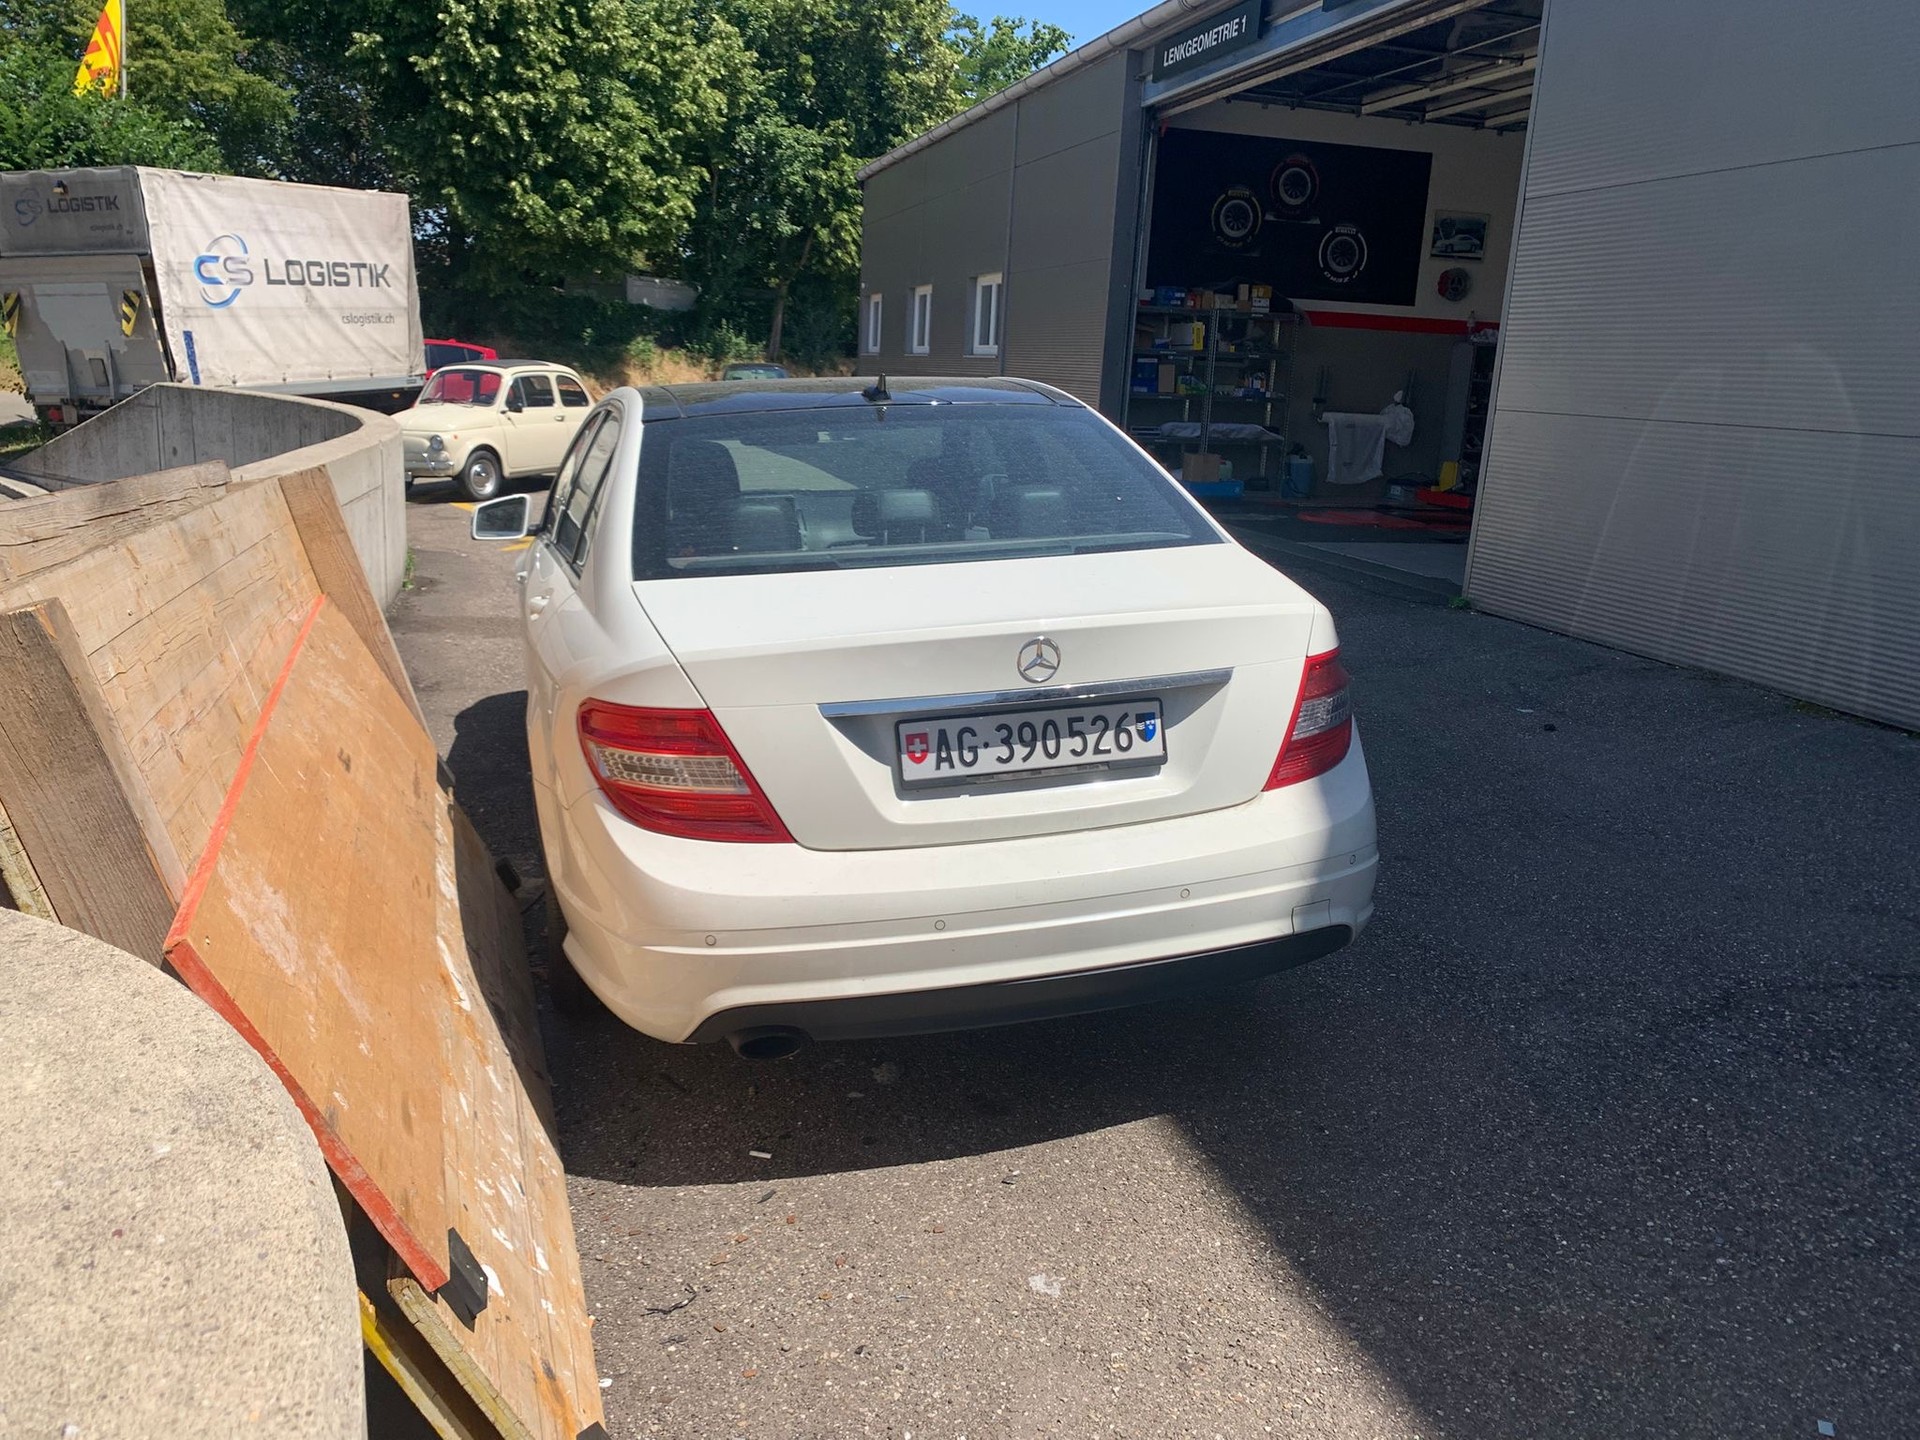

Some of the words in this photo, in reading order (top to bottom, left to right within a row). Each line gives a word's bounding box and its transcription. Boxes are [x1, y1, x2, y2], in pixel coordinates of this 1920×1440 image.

[1163, 17, 1239, 67] LENKGEOMETRIE
[1242, 15, 1247, 33] 1
[46, 195, 119, 213] LOGISTIK
[193, 255, 253, 286] CS
[264, 258, 391, 288] LOGISTIK
[341, 313, 395, 326] cslogistik.ch
